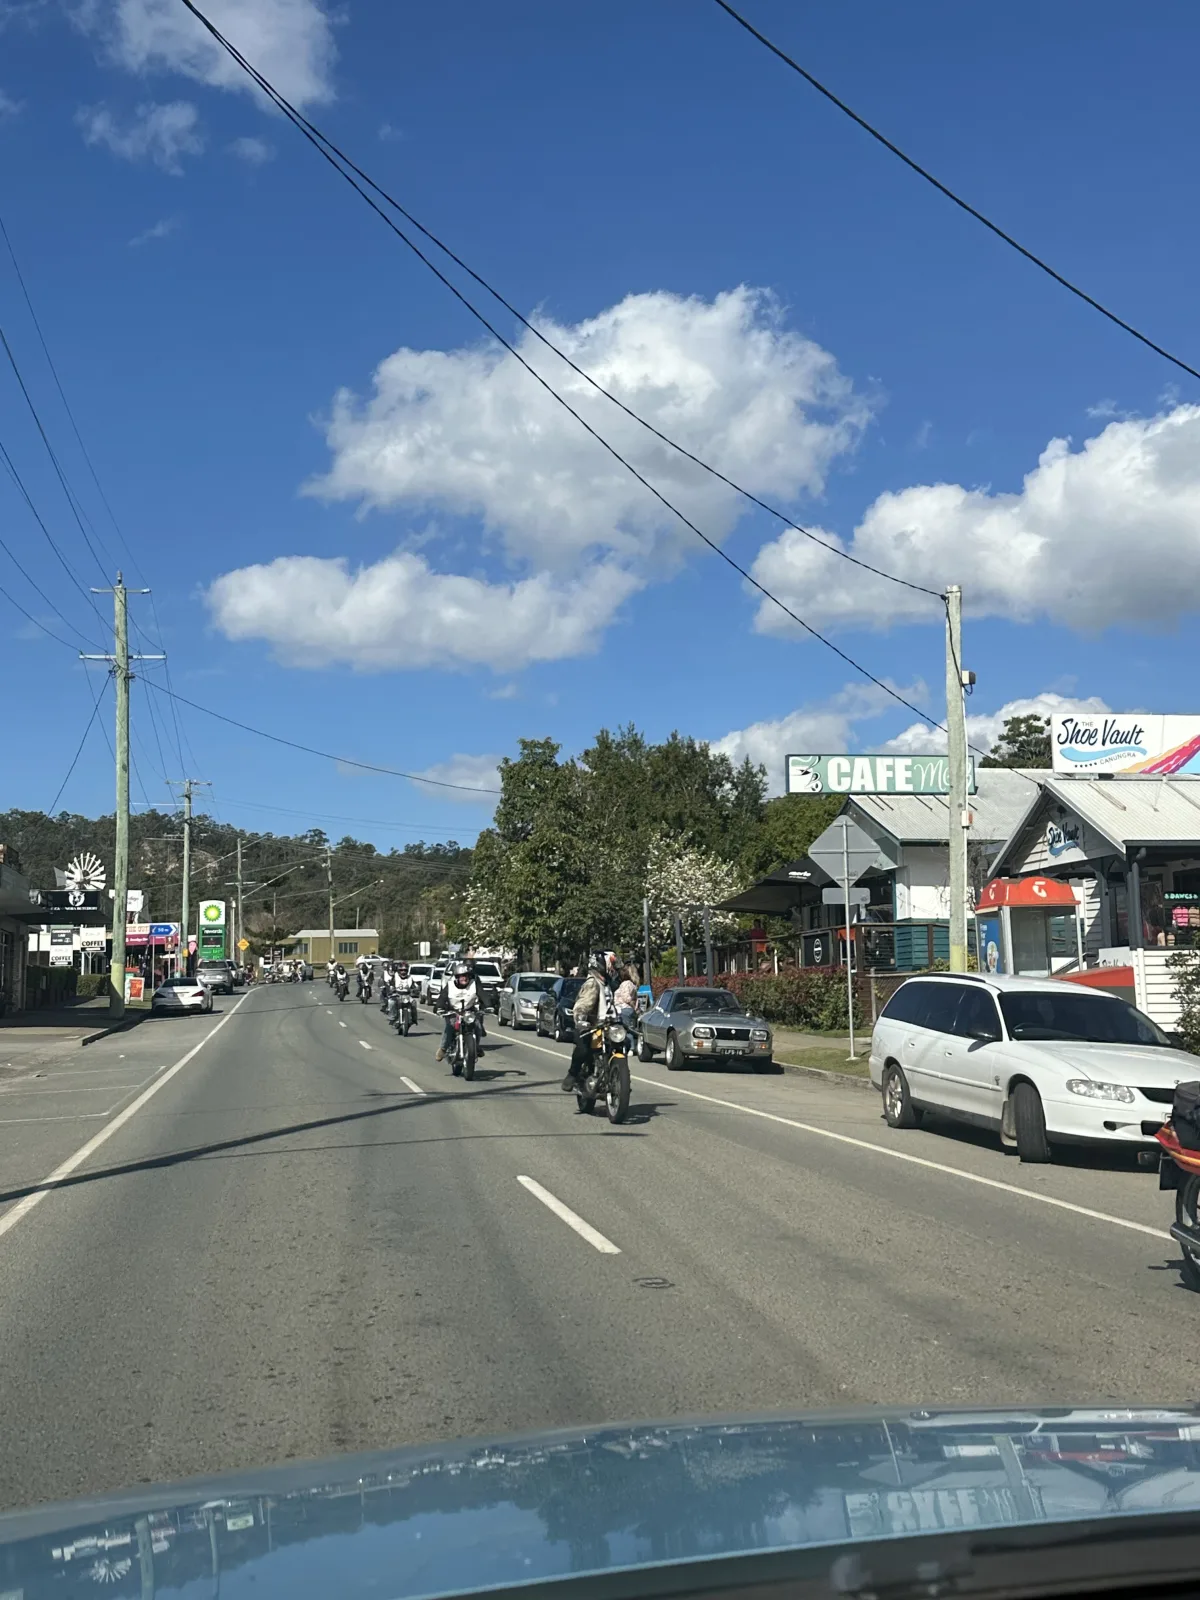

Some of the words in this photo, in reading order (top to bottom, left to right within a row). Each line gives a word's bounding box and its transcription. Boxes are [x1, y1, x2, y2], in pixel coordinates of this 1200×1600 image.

[1057, 718, 1098, 746] Shoe
[1101, 719, 1145, 747] Vault
[1099, 752, 1136, 765] CANUNGRA
[827, 757, 914, 792] CAFE
